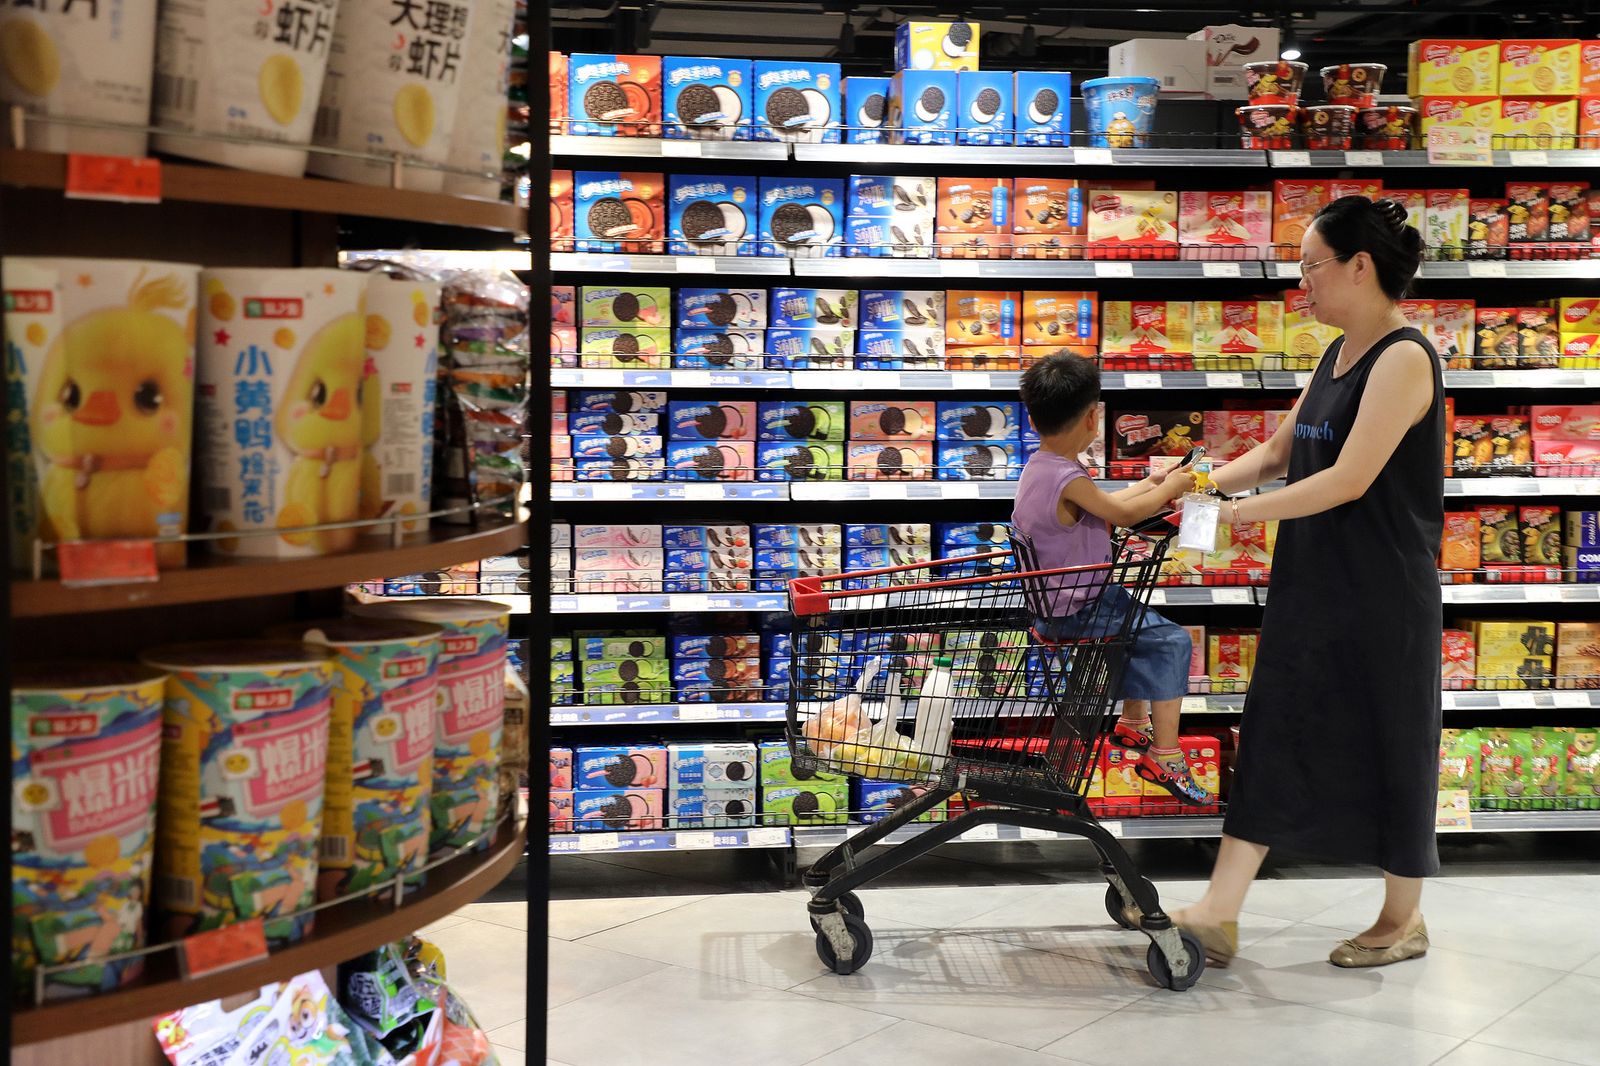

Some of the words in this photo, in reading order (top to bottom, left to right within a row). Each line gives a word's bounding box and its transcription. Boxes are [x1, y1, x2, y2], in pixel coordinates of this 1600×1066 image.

[273, 0, 333, 53] 虾片
[389, 0, 452, 37] 大理
[406, 34, 461, 84] 虾片
[233, 344, 274, 451] 小黄鸭
